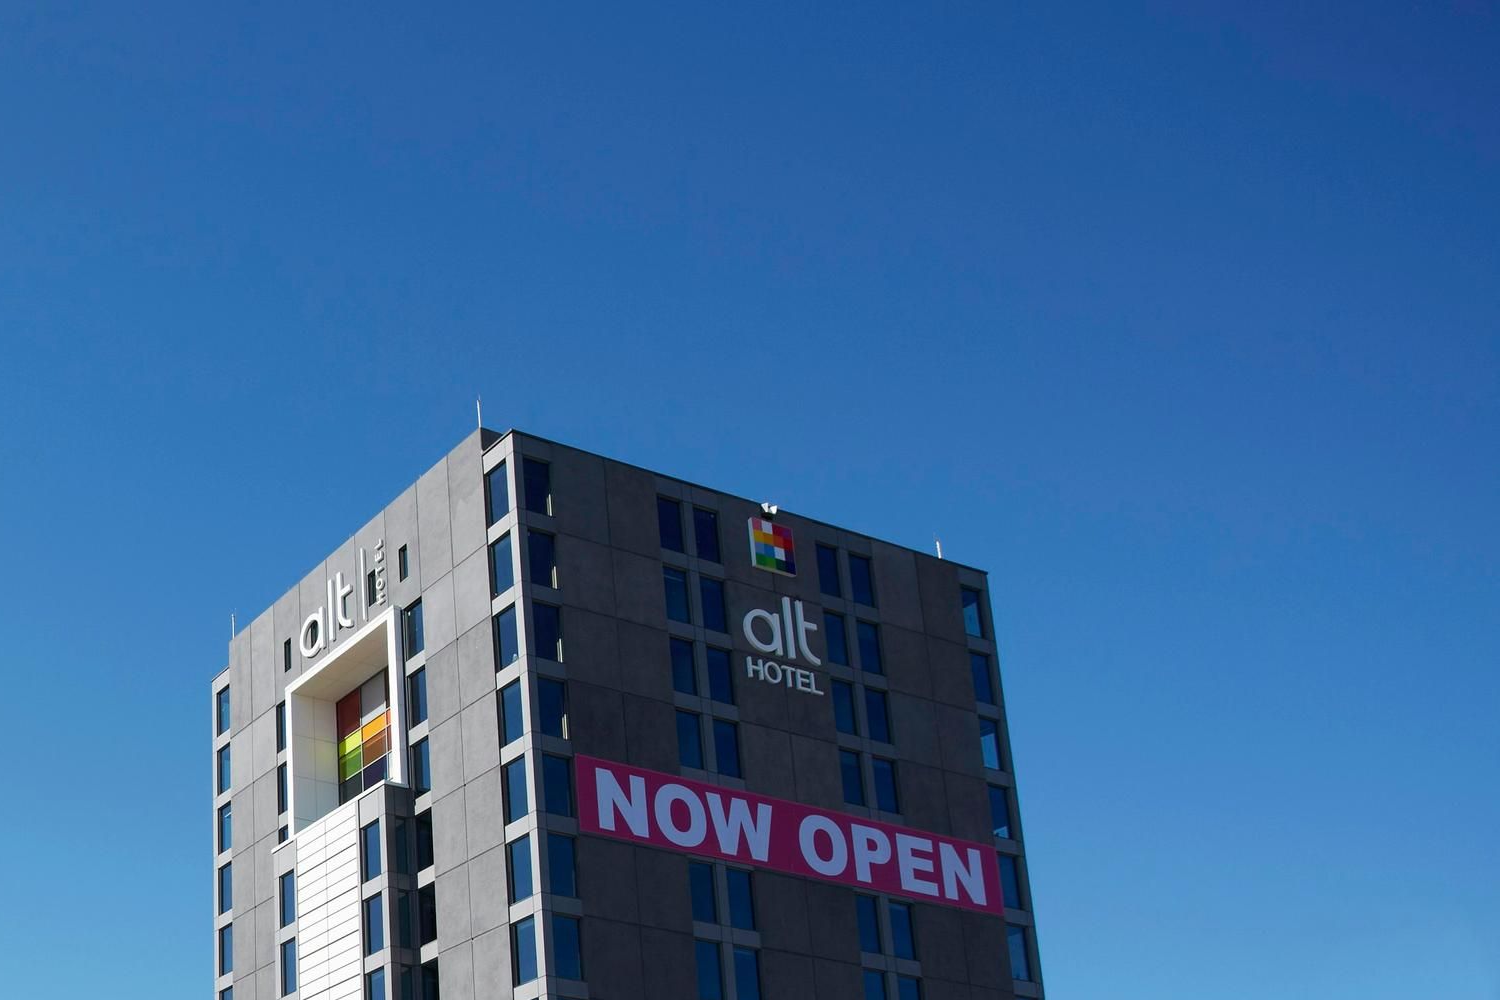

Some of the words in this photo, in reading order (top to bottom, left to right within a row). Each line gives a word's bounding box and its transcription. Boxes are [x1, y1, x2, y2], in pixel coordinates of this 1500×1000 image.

[374, 538, 386, 606] HOTEL
[300, 572, 354, 658] alt
[743, 596, 821, 666] alt
[746, 656, 824, 695] HOTEL
[595, 768, 772, 862] NOW
[799, 815, 987, 906] OPEN
